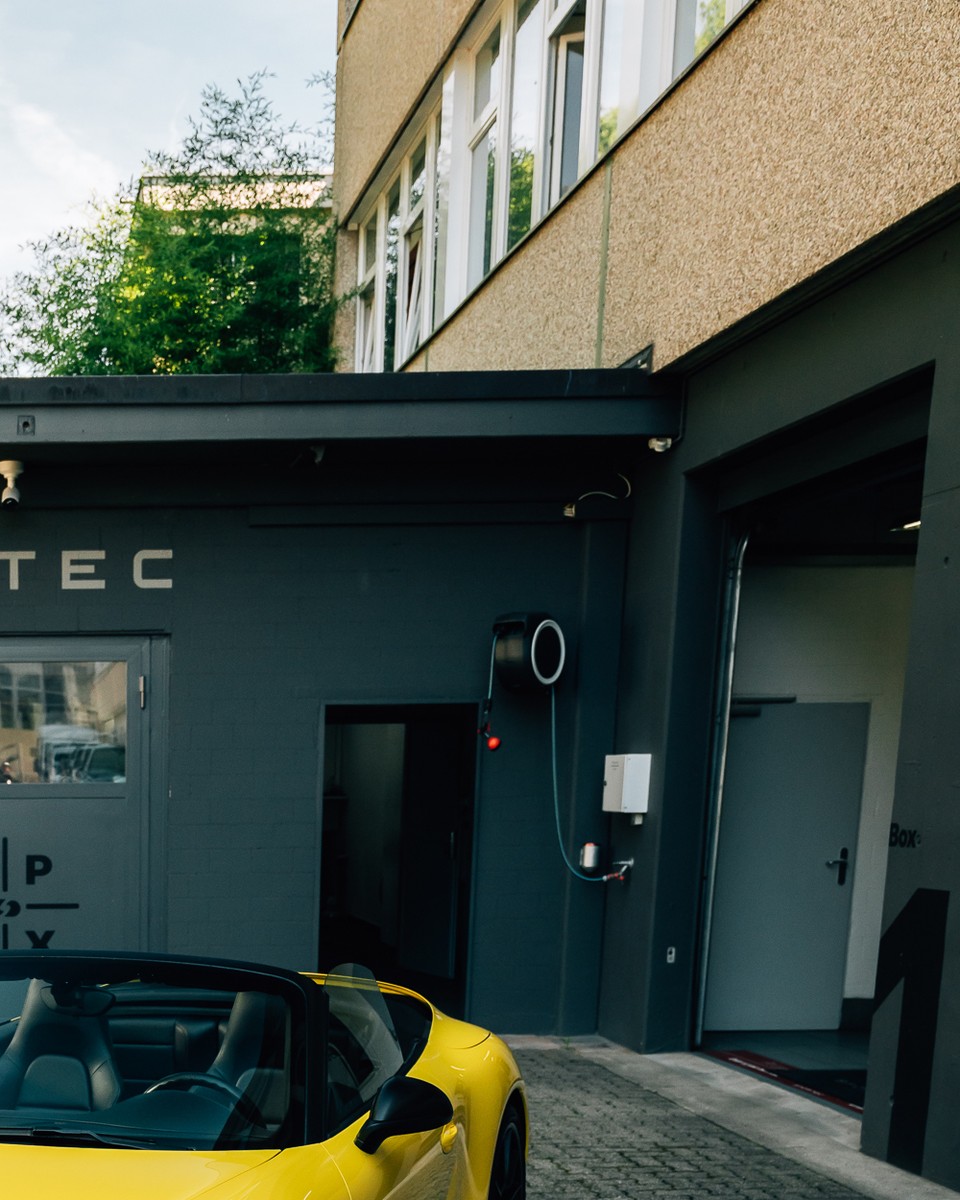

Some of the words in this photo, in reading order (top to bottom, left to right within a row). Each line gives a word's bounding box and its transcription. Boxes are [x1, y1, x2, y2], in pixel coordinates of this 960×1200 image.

[889, 822, 917, 848] Box
[26, 854, 53, 885] P
[873, 888, 950, 1177] 1
